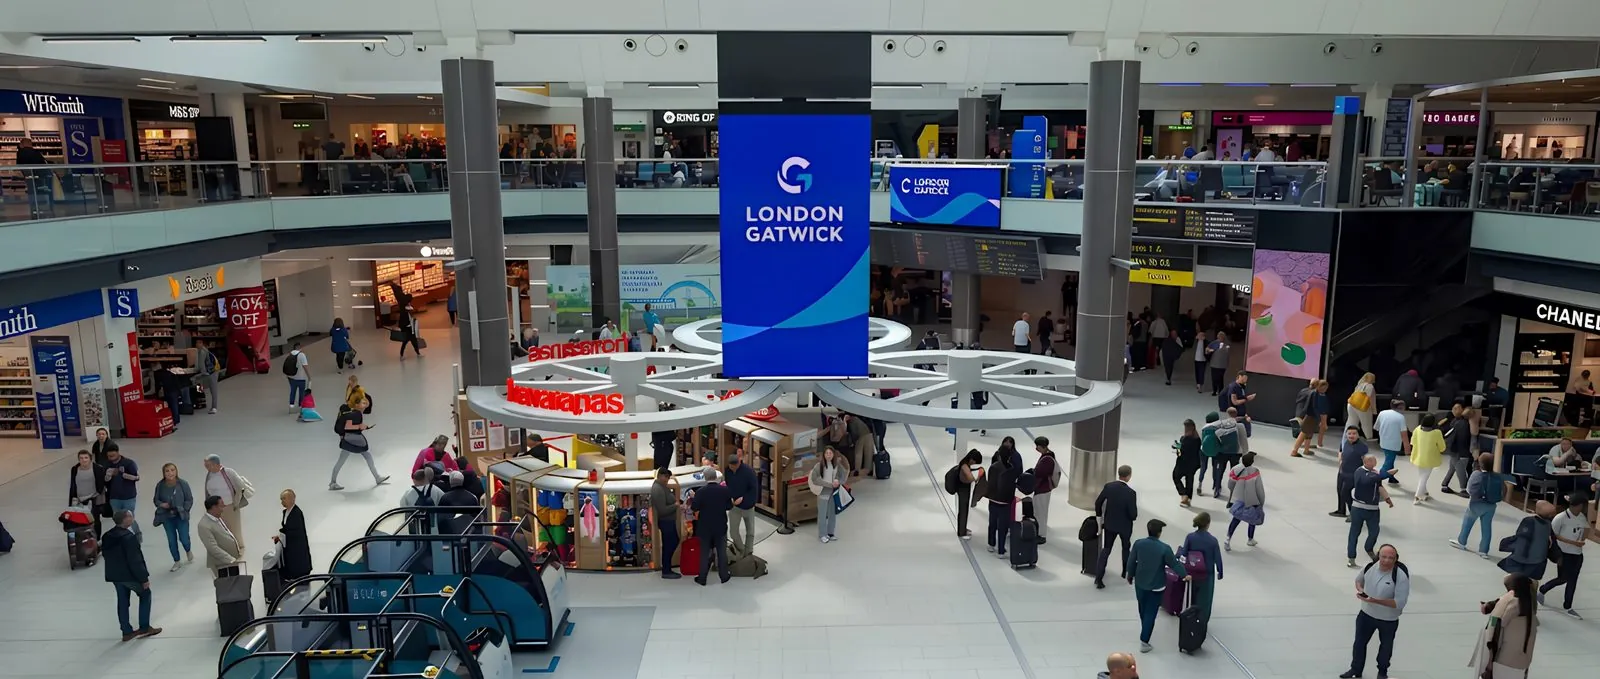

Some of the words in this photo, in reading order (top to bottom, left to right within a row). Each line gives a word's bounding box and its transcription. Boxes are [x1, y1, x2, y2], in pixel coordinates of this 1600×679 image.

[21, 93, 84, 114] WHSmith
[746, 206, 843, 222] LONDON
[745, 226, 843, 242] GATWICK
[117, 295, 132, 317] S
[231, 312, 260, 326] OFF
[1536, 303, 1600, 331] CHANEL
